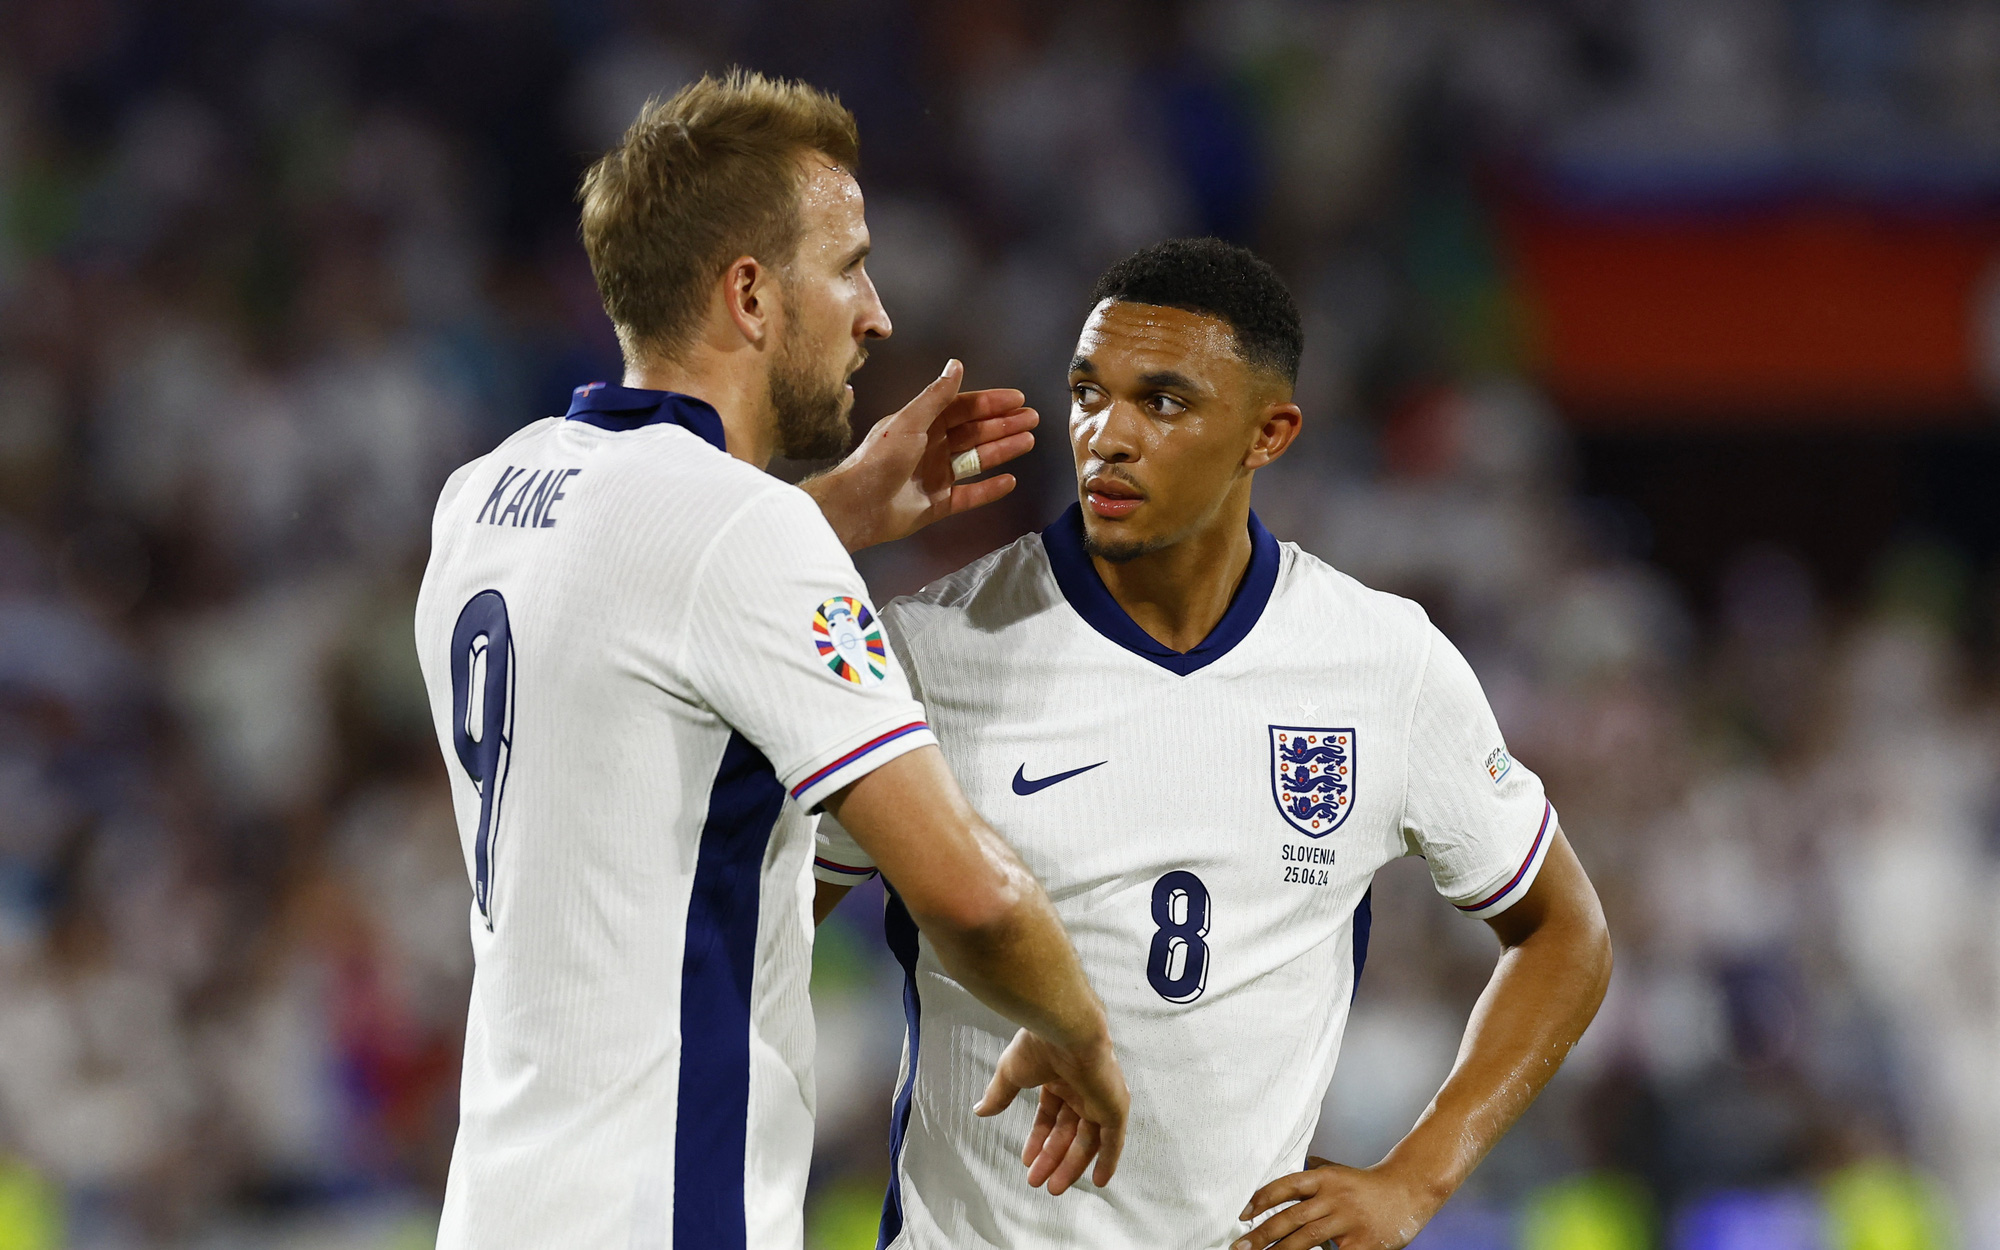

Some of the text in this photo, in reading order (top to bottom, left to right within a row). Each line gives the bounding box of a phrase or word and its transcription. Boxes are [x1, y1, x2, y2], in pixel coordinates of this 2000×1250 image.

[476, 465, 582, 528] KANE
[451, 589, 515, 933] 9
[1282, 844, 1335, 865] SLOVENIA
[1283, 866, 1329, 886] 25.06.24
[1147, 870, 1211, 1004] 8
